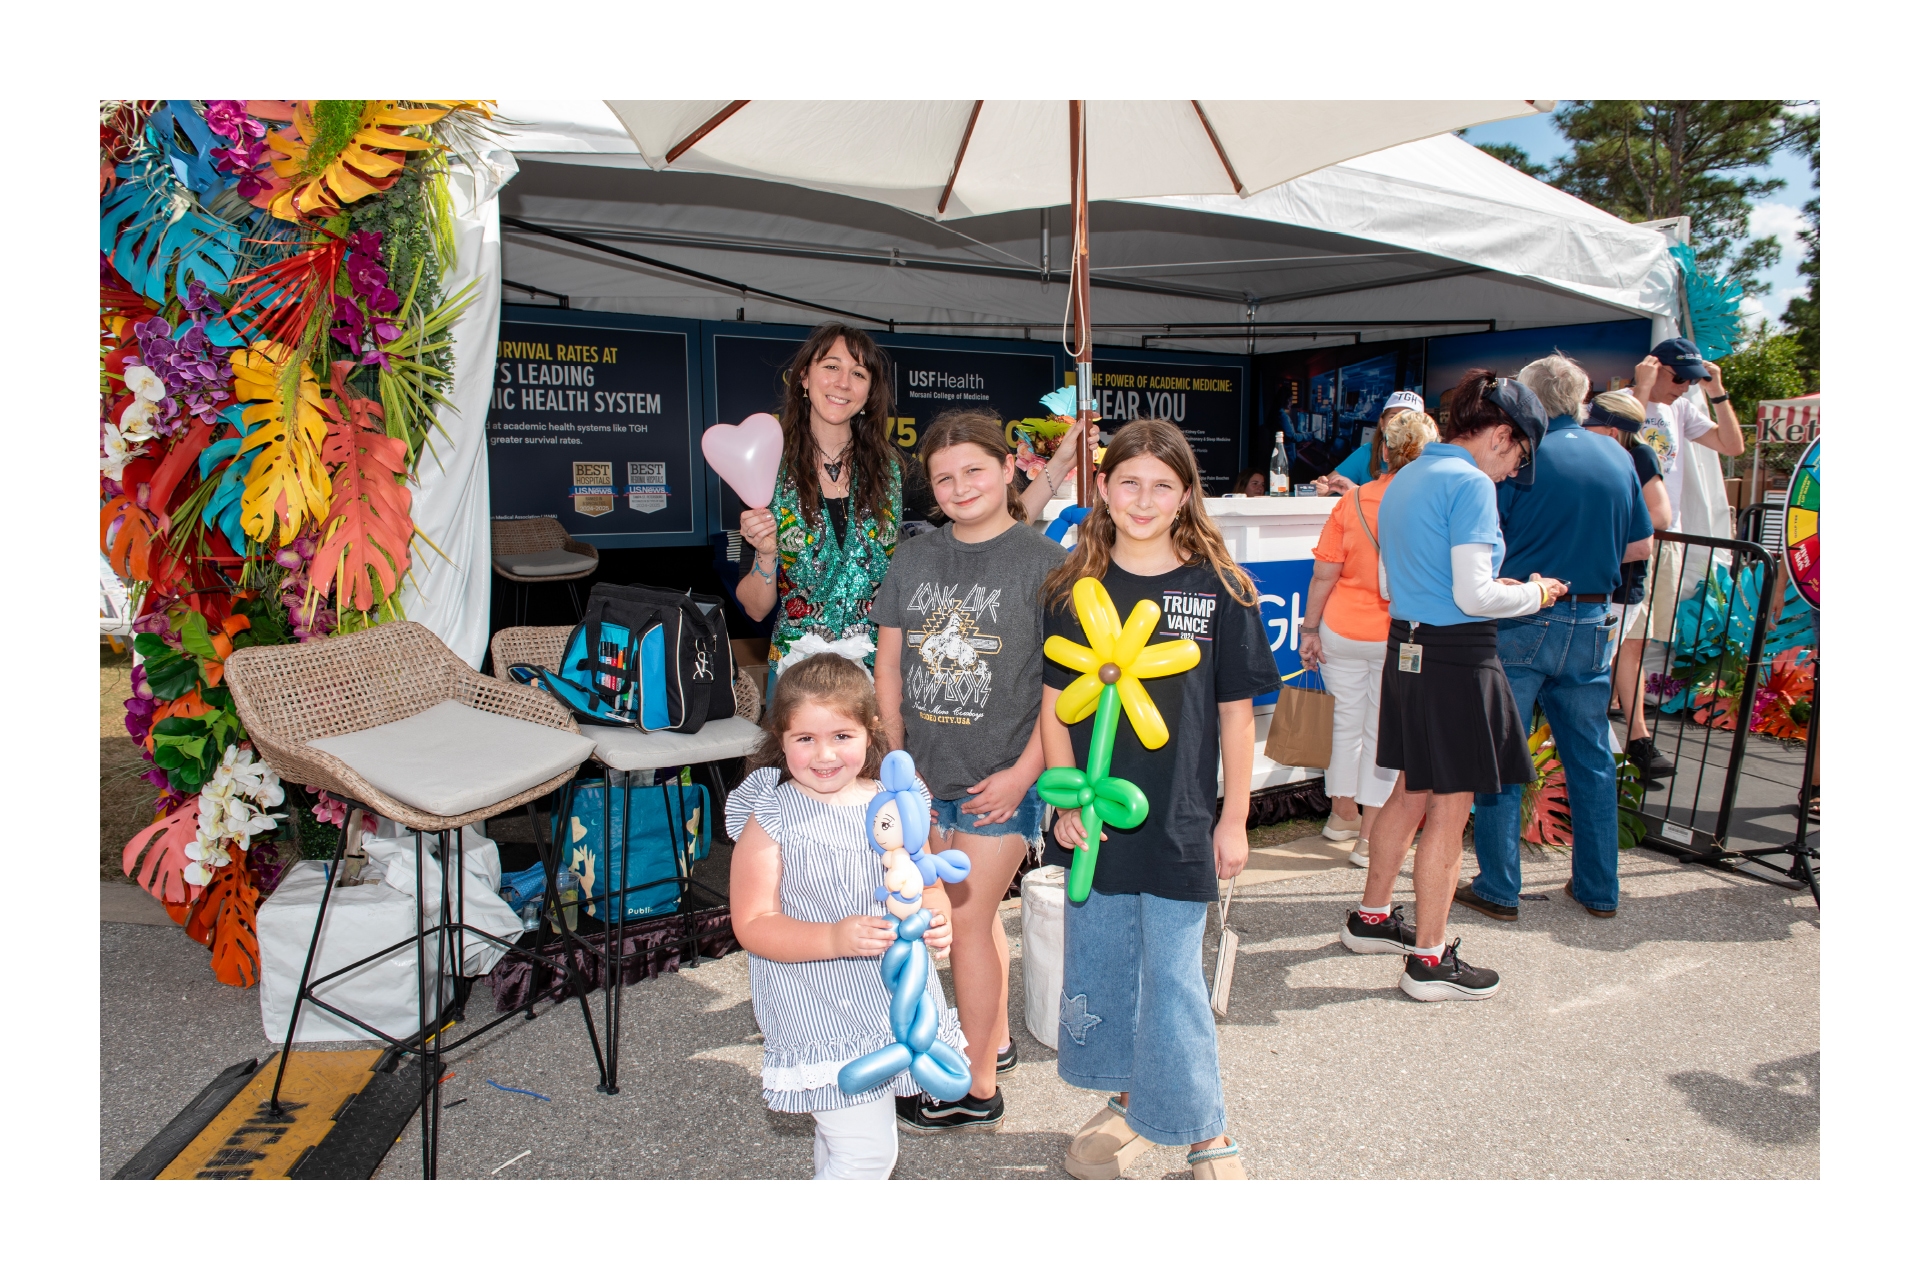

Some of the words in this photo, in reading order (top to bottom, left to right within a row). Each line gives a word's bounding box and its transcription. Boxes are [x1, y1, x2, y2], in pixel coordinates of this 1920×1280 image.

[556, 344, 599, 363] RATES
[602, 347, 618, 364] AT
[495, 362, 512, 384] 'S
[517, 363, 595, 387] LEADING
[1092, 373, 1103, 386] HE
[1105, 373, 1135, 388] POWER
[1137, 375, 1148, 388] OF
[1149, 376, 1191, 391] ACADEMIC
[1192, 378, 1233, 392] MEDICINE:
[521, 388, 589, 412] HEALTH
[594, 391, 662, 414] SYSTEM
[909, 390, 932, 399] Morsani
[933, 391, 955, 400] College
[963, 393, 990, 401] Medicine
[1397, 392, 1418, 405] TGH
[1146, 391, 1186, 422] YOU
[492, 422, 502, 430] at
[503, 421, 547, 431] academic
[548, 422, 576, 432] health
[576, 424, 611, 434] systems
[612, 423, 627, 433] like
[628, 424, 648, 433] TGH
[490, 436, 523, 446] greater
[524, 435, 558, 445] survival
[559, 436, 583, 445] rates.
[575, 464, 610, 476] BEST
[630, 463, 663, 475] BEST
[576, 476, 611, 485] HOSPITALS
[646, 475, 664, 484] HOSPITALS
[1794, 551, 1805, 571] SPIN
[1162, 595, 1216, 618] TRUMP
[1167, 614, 1209, 634] VANCE
[1180, 632, 1195, 640] 2024
[907, 663, 992, 709] COWBOYS
[628, 906, 653, 915] Publi
